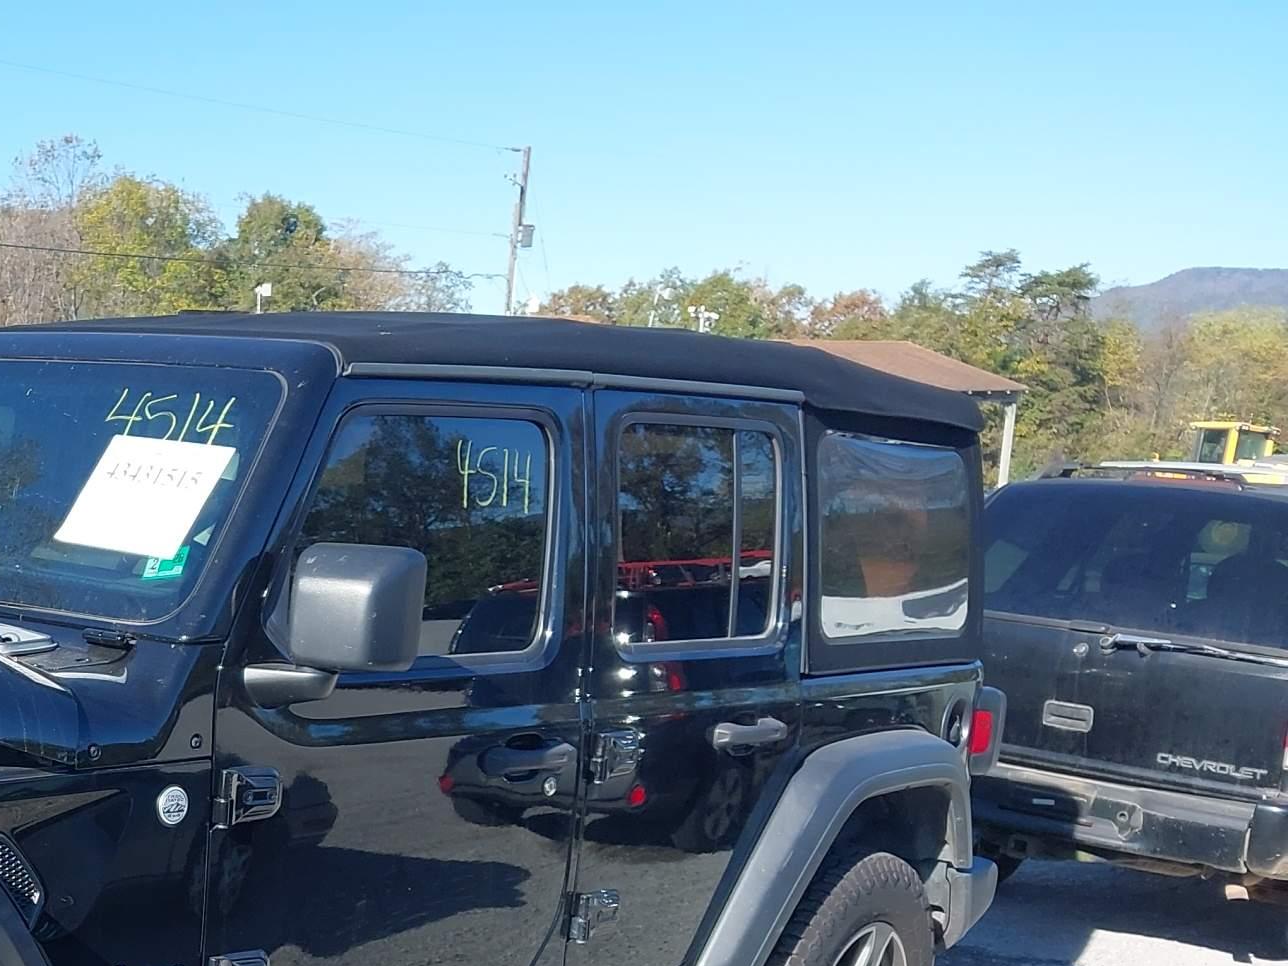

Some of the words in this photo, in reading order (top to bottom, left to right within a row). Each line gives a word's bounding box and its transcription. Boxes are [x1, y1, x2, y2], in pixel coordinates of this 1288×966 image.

[105, 388, 237, 445] 4514
[457, 439, 532, 514] 4514
[1156, 752, 1268, 781] CHEVROLET
